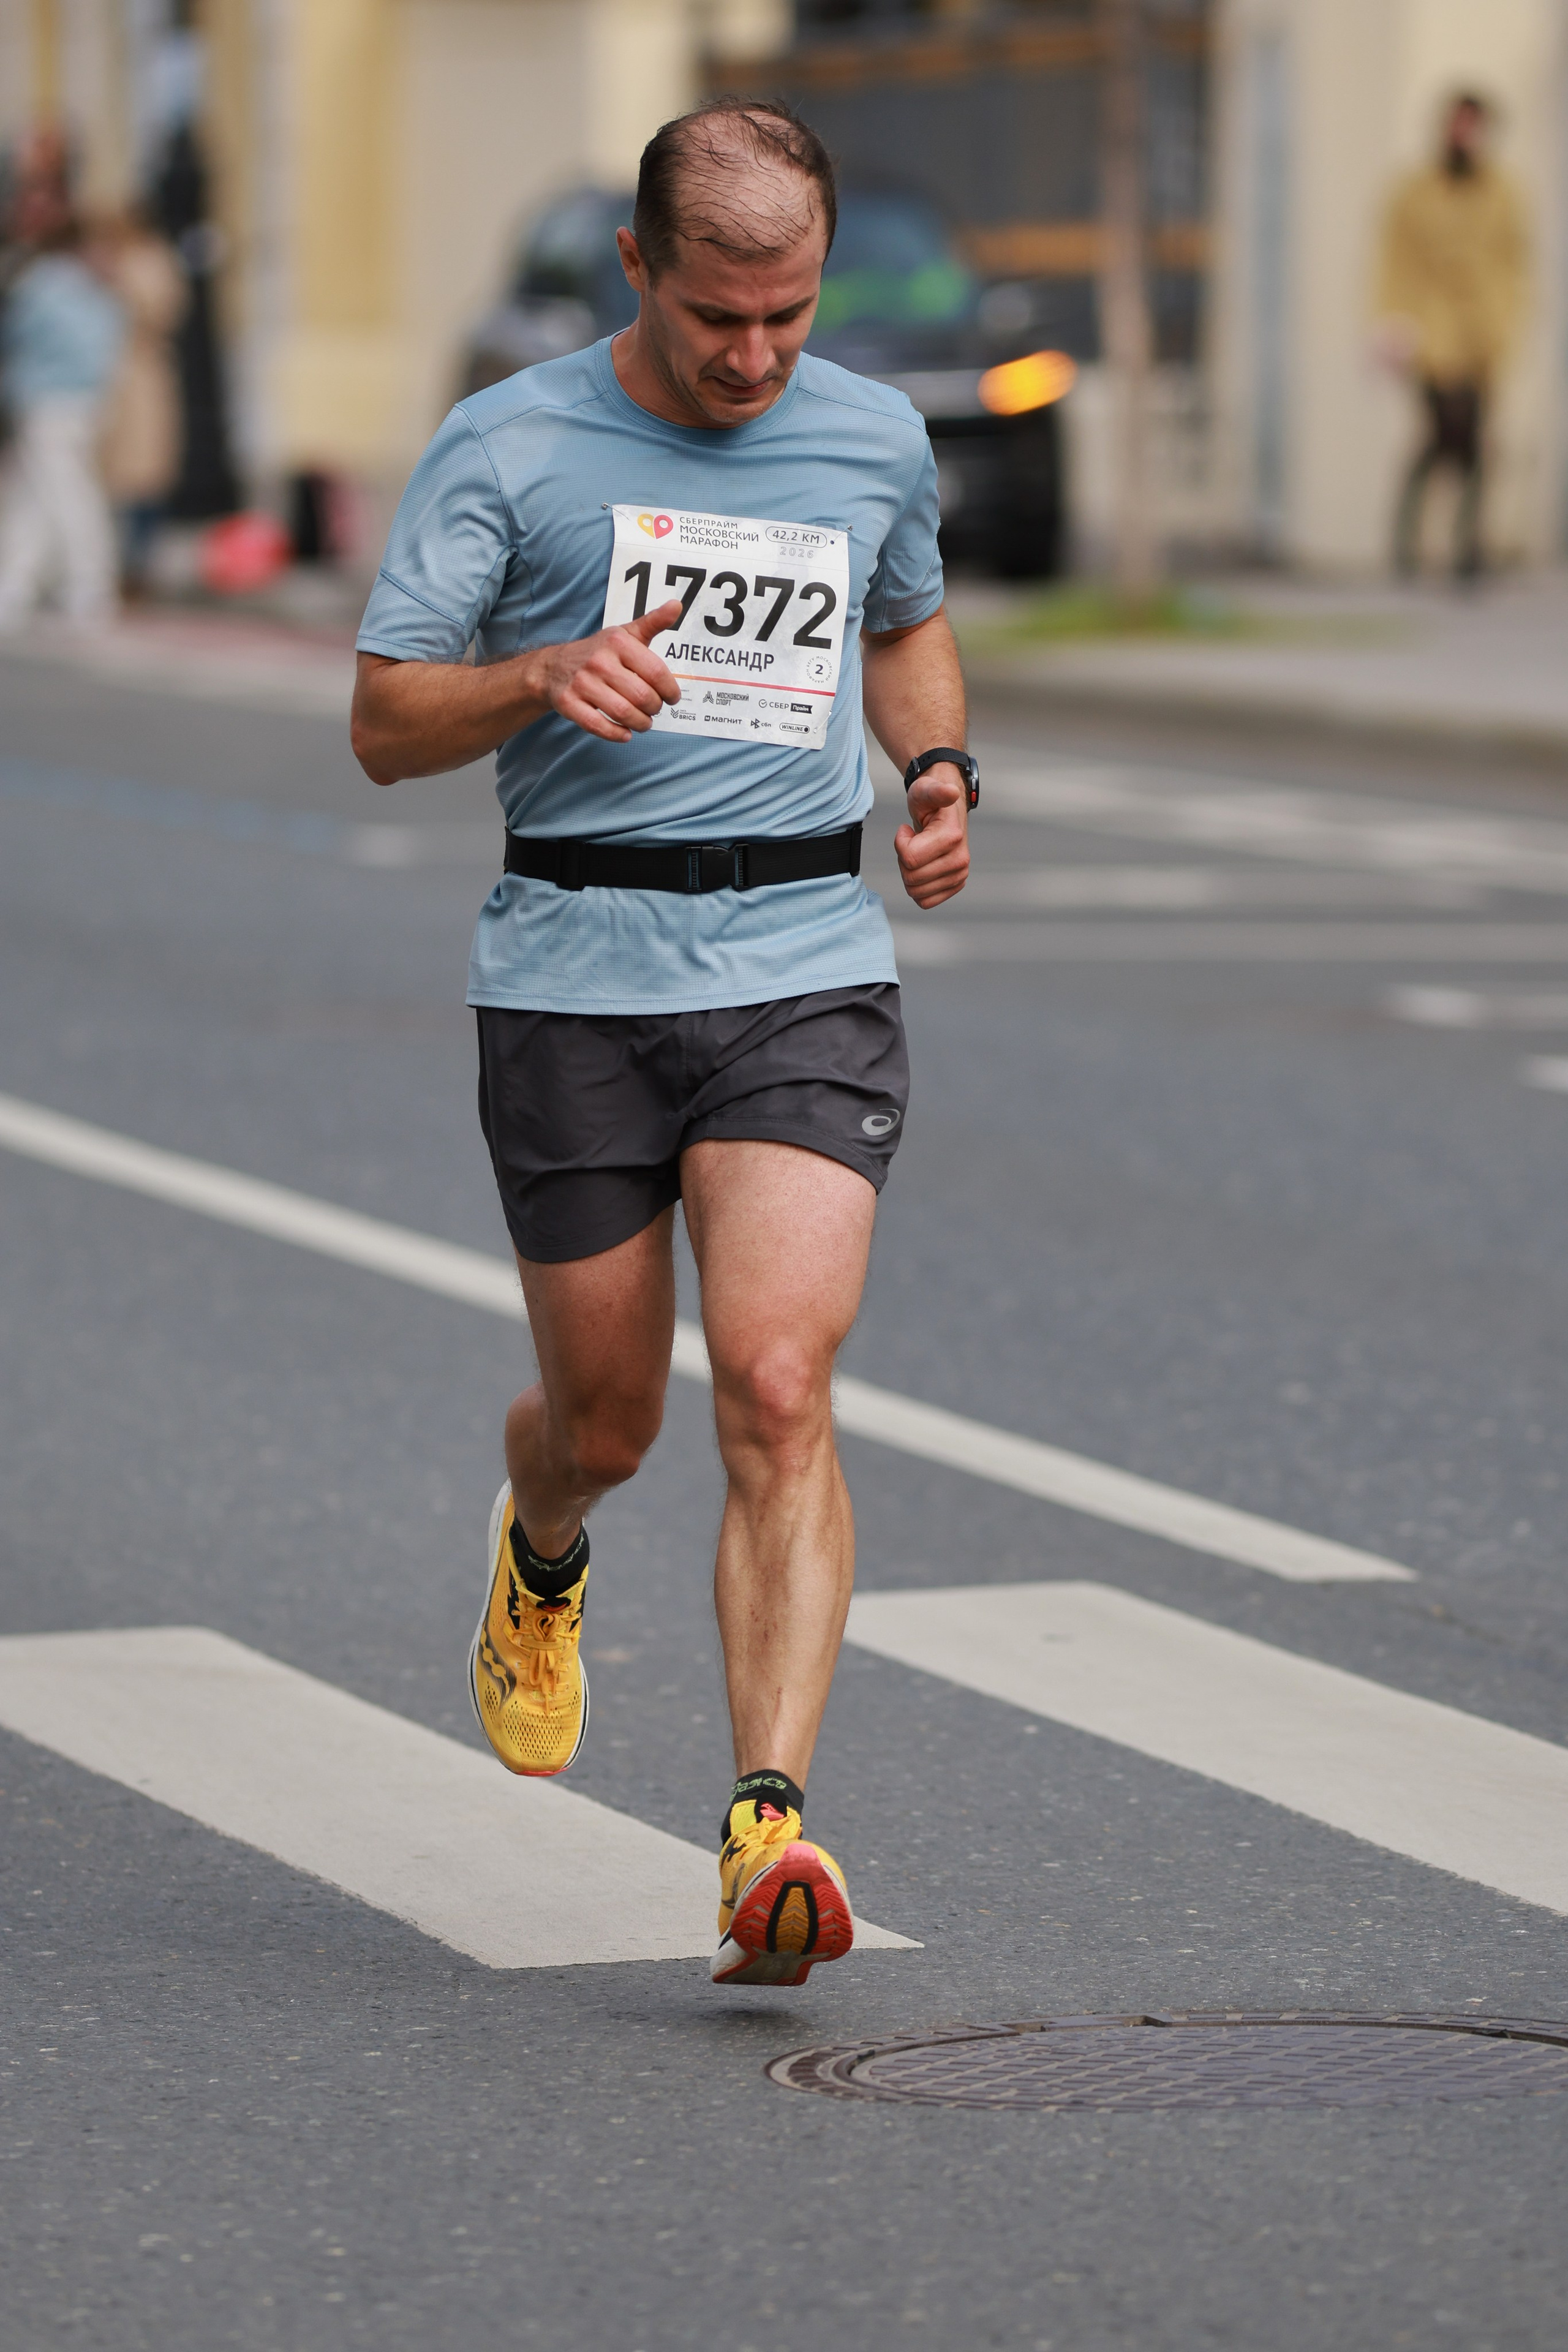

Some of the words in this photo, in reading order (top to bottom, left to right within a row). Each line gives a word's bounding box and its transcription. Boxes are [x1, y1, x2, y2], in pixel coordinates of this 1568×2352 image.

[679, 516, 738, 529] СБЕРПРАЙМ
[680, 525, 759, 542] МОСКОВСКИЙ
[772, 530, 797, 541] 42,2
[802, 533, 820, 544] КМ
[680, 535, 738, 549] МАРАФОН
[780, 546, 814, 559] 2026
[624, 560, 837, 650] 17372
[665, 642, 775, 673] АЛЕКСАНДР
[815, 664, 823, 675] 2
[716, 692, 749, 702] МОСКОВСКИЙ
